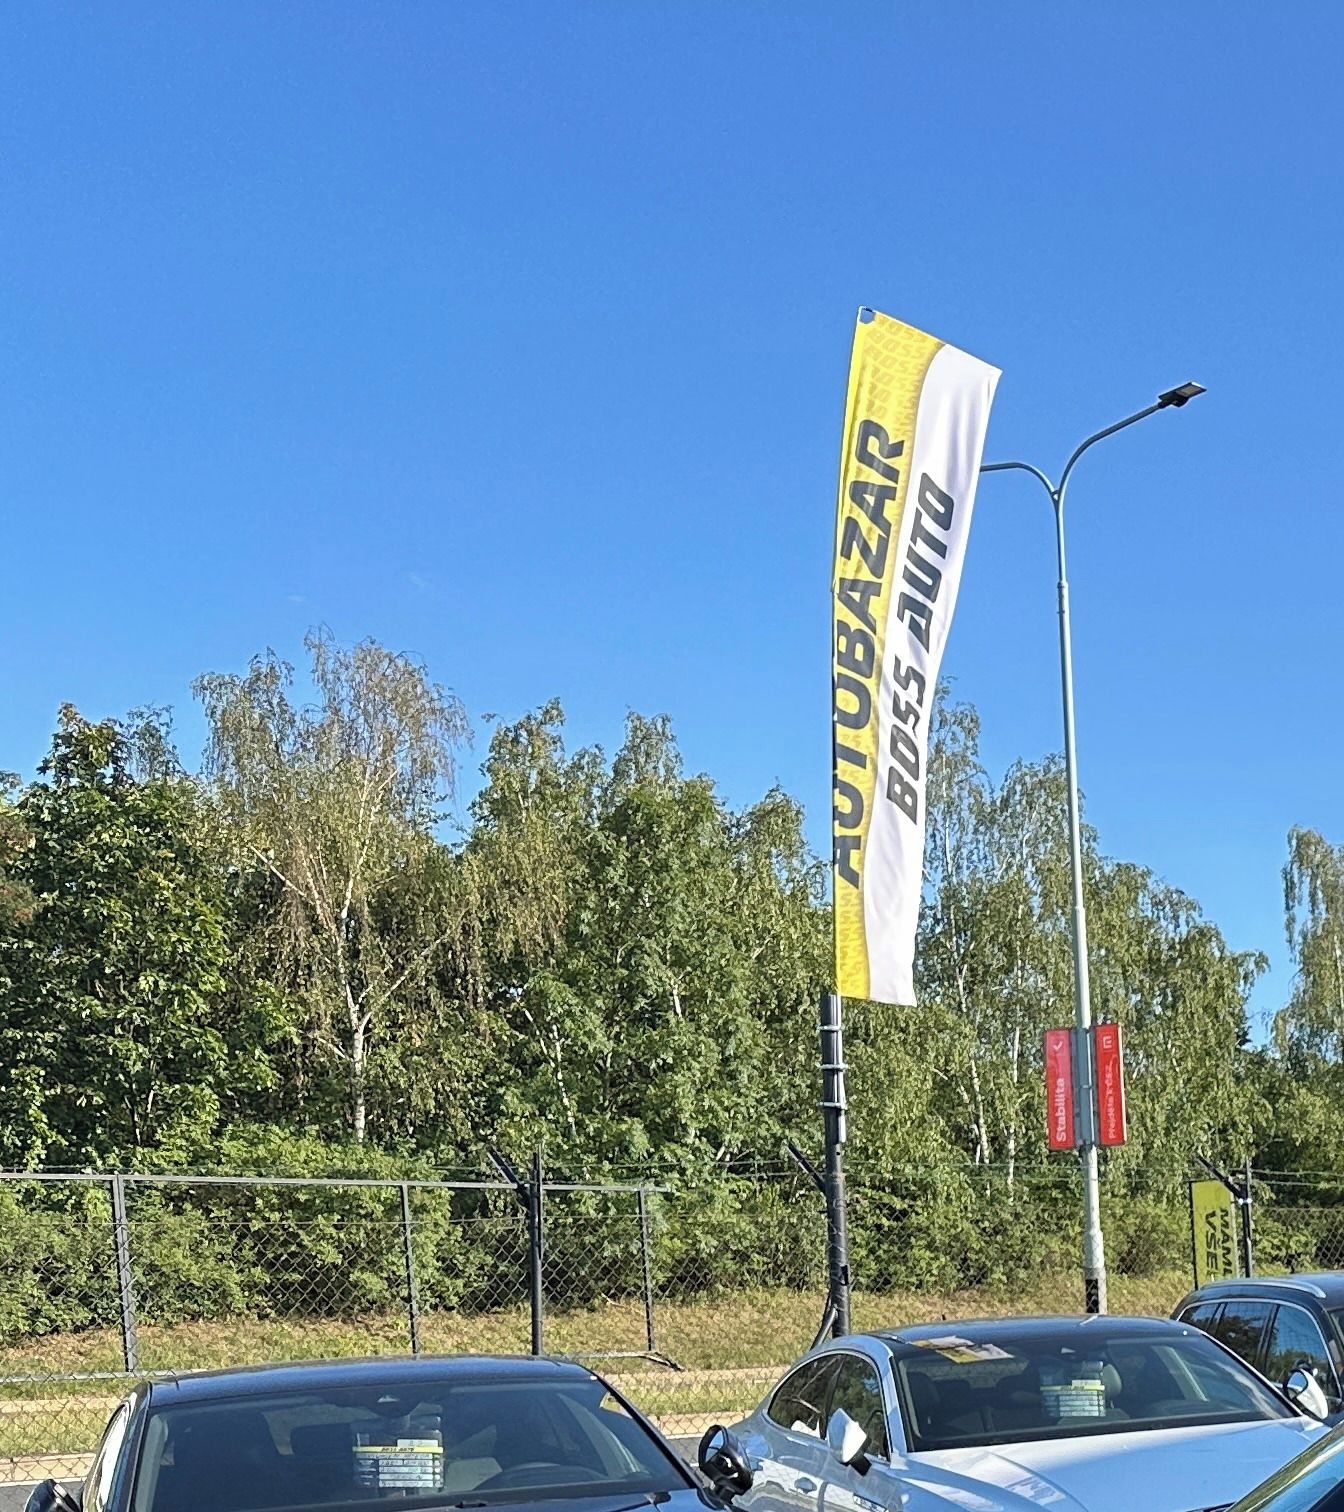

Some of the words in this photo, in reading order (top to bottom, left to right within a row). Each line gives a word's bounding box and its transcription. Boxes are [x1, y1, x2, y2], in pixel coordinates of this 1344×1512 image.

[897, 472, 955, 654] AUTO
[834, 419, 905, 889] AUTOBAZAR
[887, 654, 926, 826] BOSS
[1055, 1078, 1067, 1142] Stabilita
